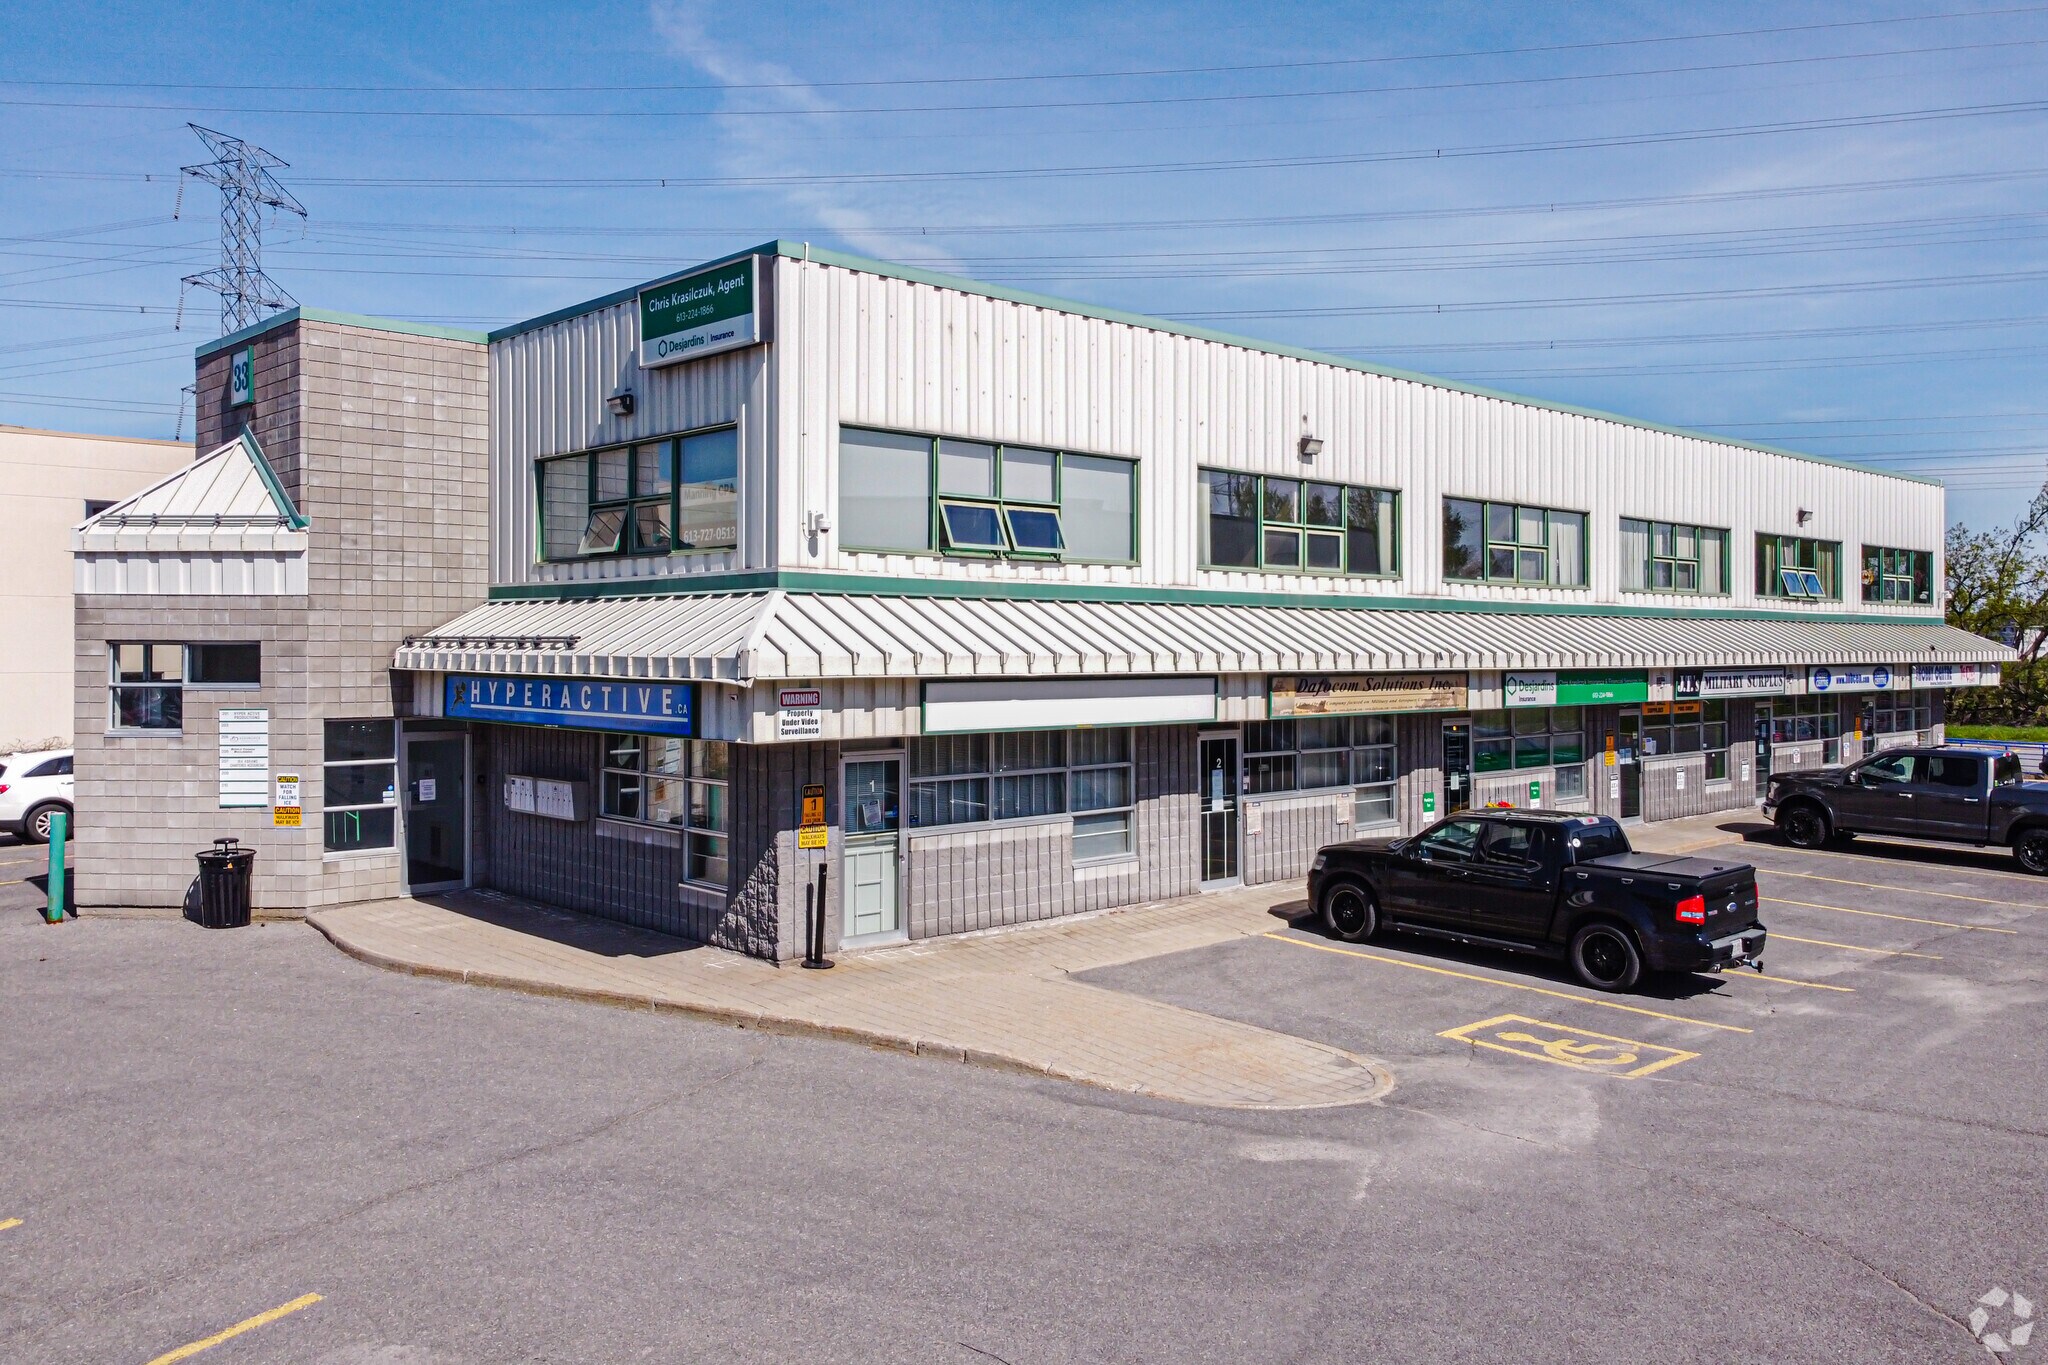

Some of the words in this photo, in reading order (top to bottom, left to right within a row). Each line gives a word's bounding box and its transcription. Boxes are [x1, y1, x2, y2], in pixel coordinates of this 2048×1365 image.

[649, 297, 669, 312] Chris
[671, 283, 716, 306] Krasilczuk,
[717, 274, 745, 294] Agent
[676, 304, 714, 323] 613-224-1866
[669, 335, 704, 352] Desjardins
[710, 330, 735, 342] Insurance
[684, 526, 736, 543] 613-727-0513
[1296, 678, 1358, 697] Dafocom
[1363, 677, 1424, 692] Solutions
[1519, 680, 1555, 694] Desjardins
[1704, 675, 1744, 690] MILITARY
[1747, 674, 1783, 688] SURPLUS
[782, 692, 819, 705] WARNING
[801, 718, 819, 726] Video
[781, 727, 819, 736] Surveillance
[1216, 757, 1222, 769] 2
[869, 779, 875, 793] 1
[800, 825, 826, 833] CAUTION
